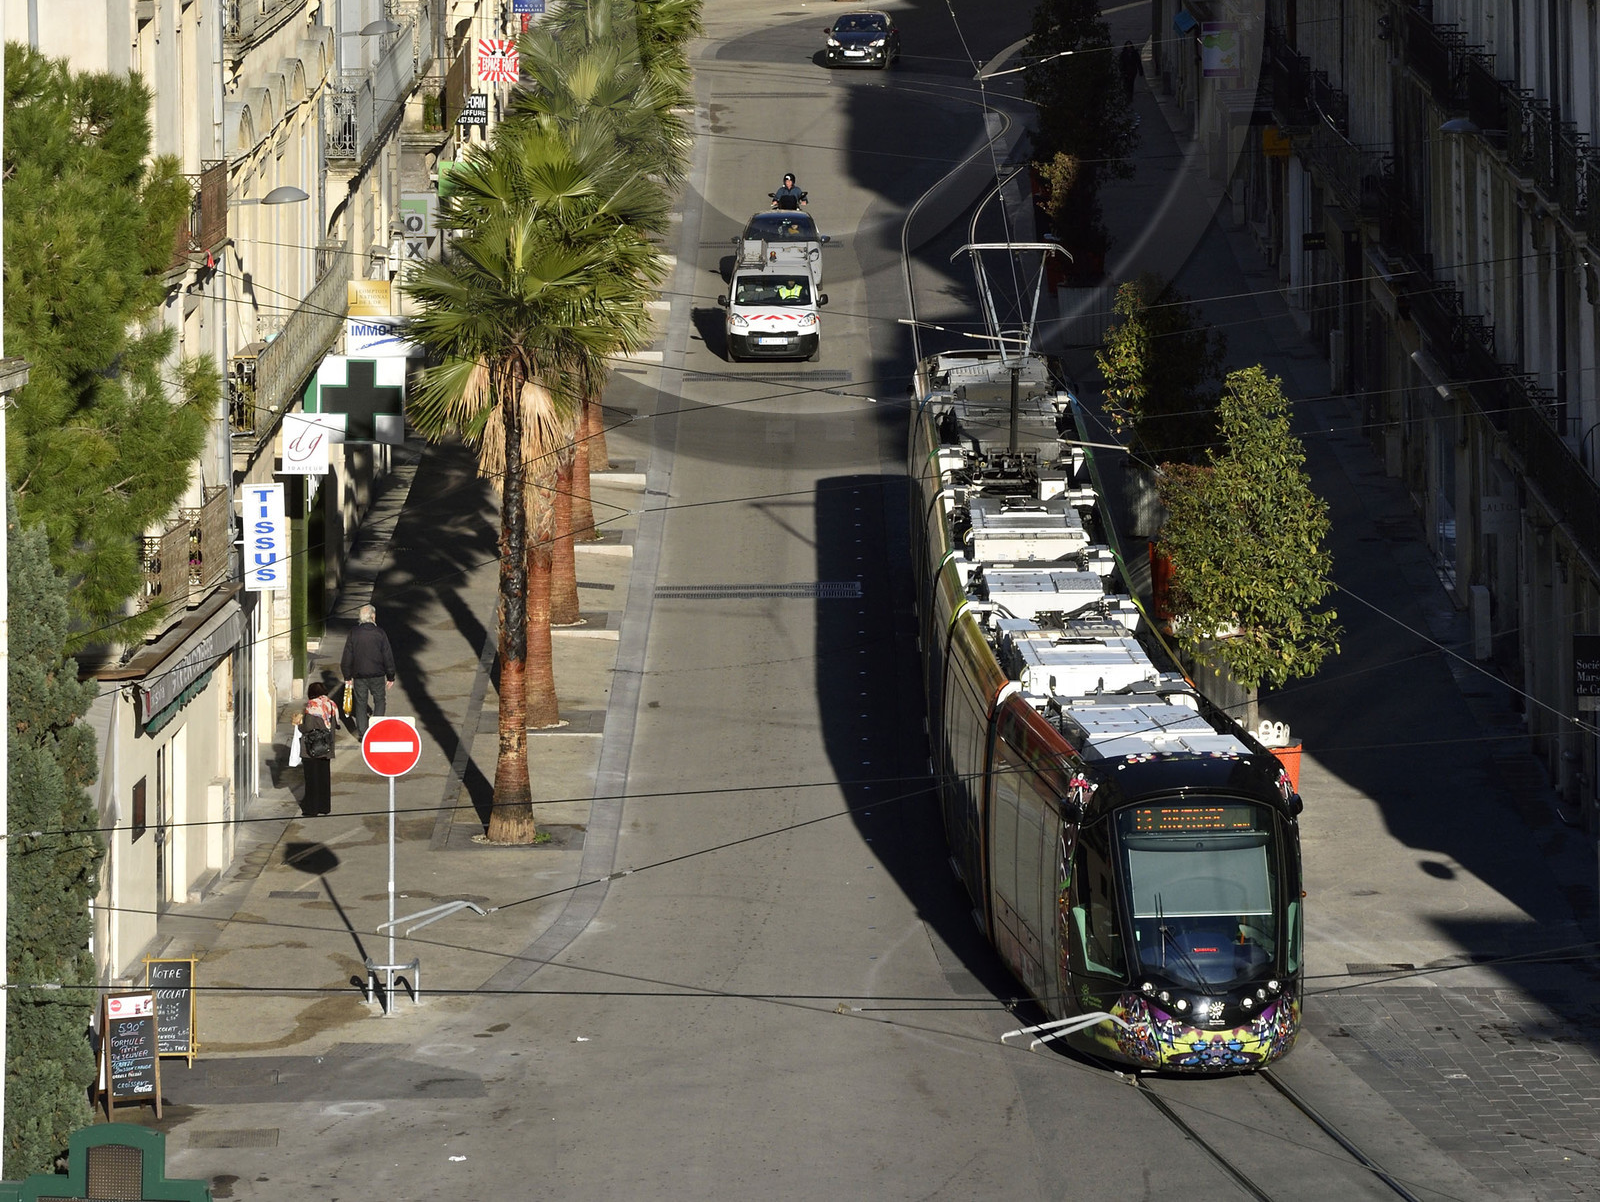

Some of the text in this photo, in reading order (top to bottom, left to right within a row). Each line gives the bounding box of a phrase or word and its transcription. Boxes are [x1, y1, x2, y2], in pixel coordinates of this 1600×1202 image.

[482, 57, 500, 71] ESPACE
[253, 489, 276, 581] TISSUS
[1576, 684, 1588, 694] de
[152, 964, 183, 979] NOTRE
